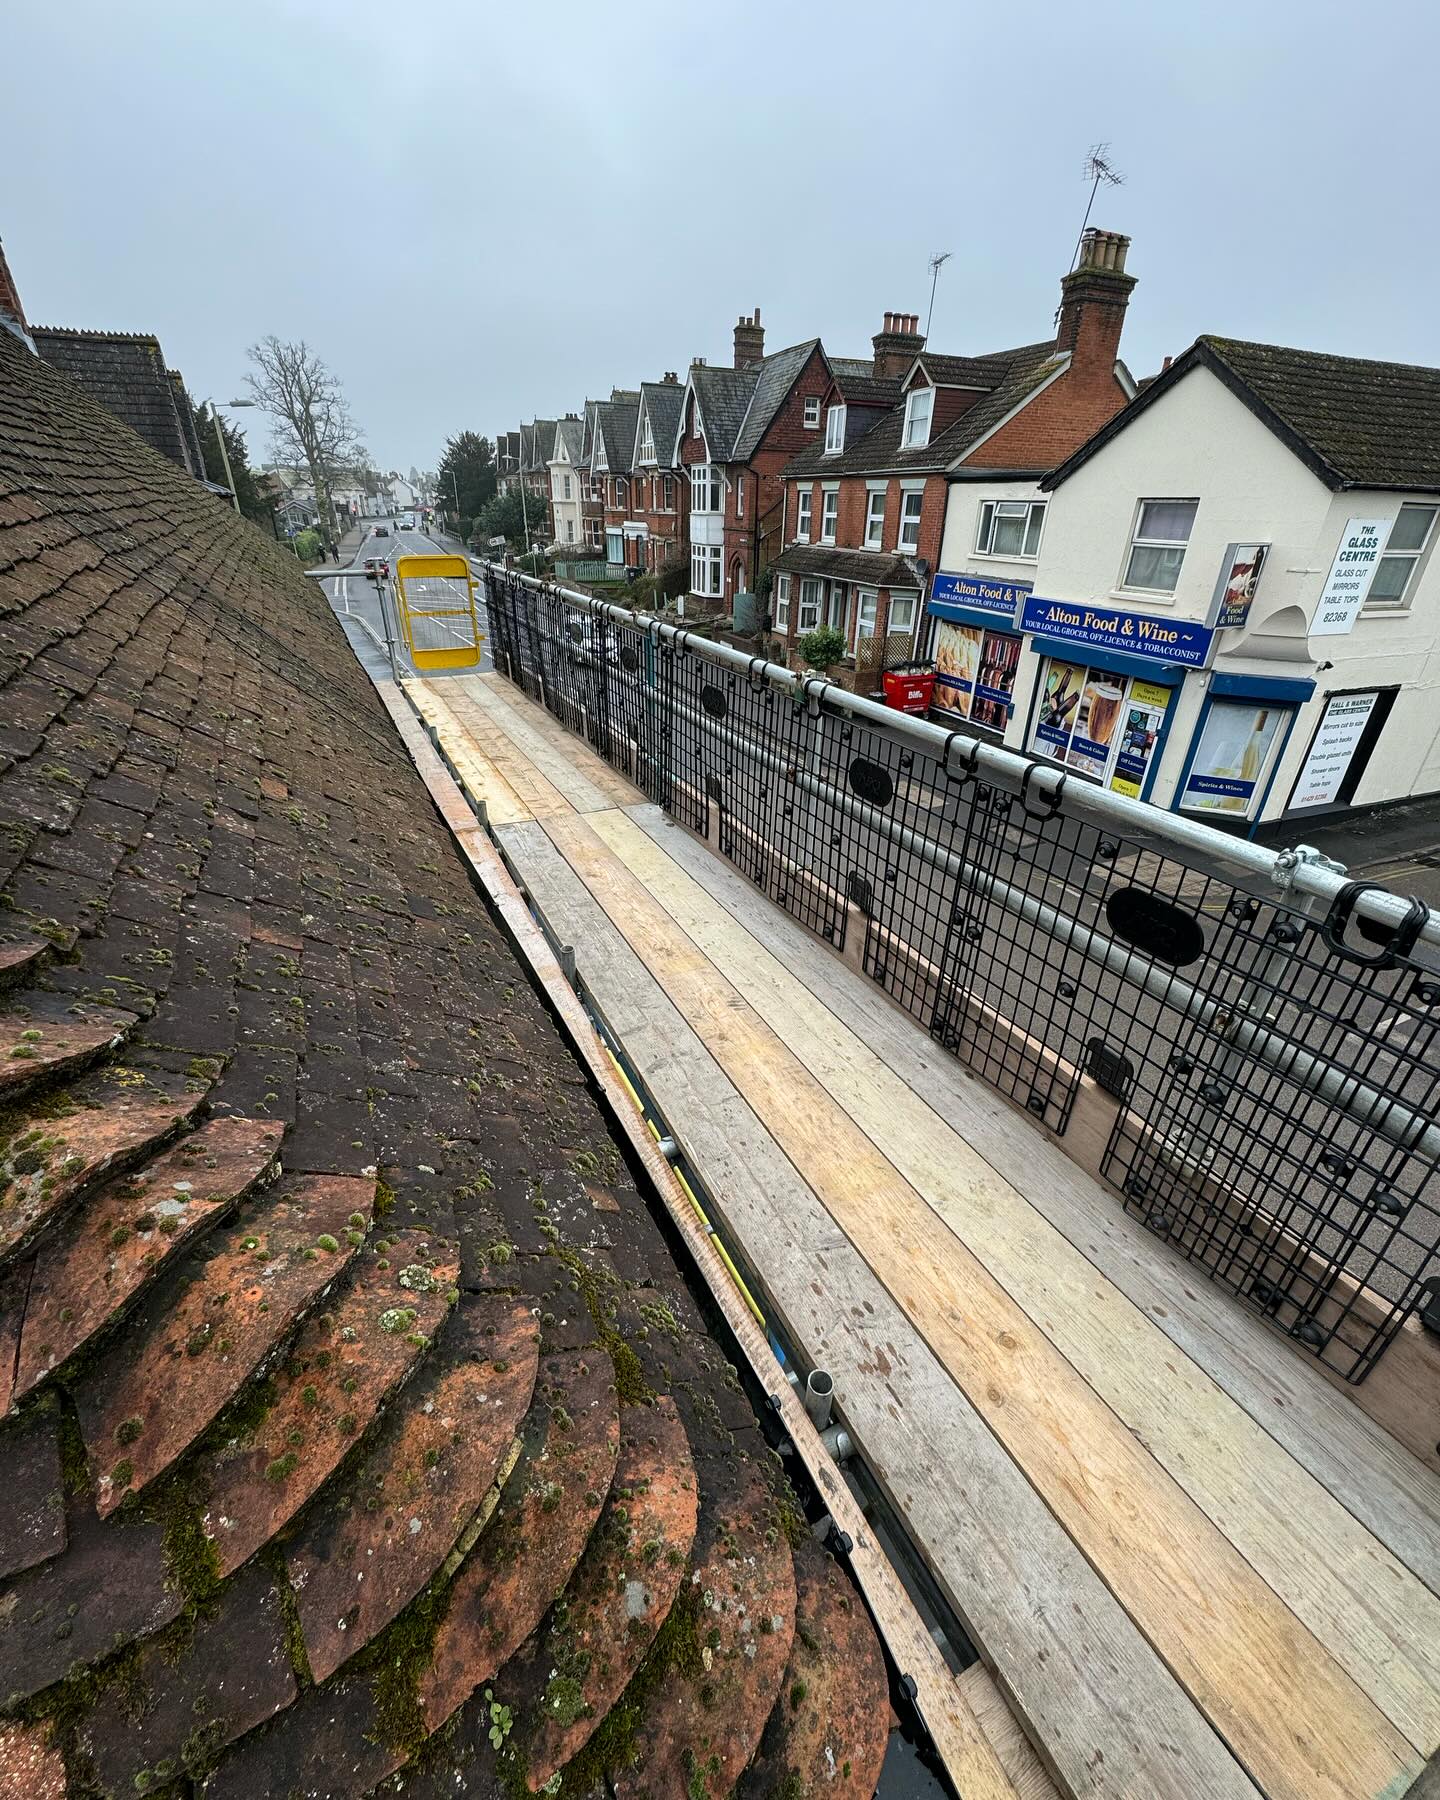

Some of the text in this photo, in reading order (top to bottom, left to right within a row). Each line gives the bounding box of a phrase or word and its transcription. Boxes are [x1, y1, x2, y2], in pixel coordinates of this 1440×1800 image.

[1360, 526, 1376, 535] THE
[1348, 537, 1379, 548] GLASS
[1339, 551, 1377, 562] CENTRE
[1335, 569, 1368, 577] GLASS CUT
[953, 581, 977, 597] Alton
[978, 584, 1002, 600] Food
[1004, 588, 1014, 601] &
[1332, 582, 1360, 591] MIRRORS
[951, 593, 963, 601] LOCAL
[1324, 595, 1359, 604] TABLE TOPS
[1226, 606, 1244, 615] Food
[1227, 616, 1245, 624] Wine
[1323, 612, 1348, 622] 82368
[1045, 606, 1080, 626] Alton
[1082, 612, 1119, 633] Food
[1121, 618, 1134, 636] &
[1138, 621, 1178, 643] Wine
[1025, 619, 1201, 660] YOUR LOCAL GROCER, OFF-LICENCE & TOBACCONIST
[908, 690, 923, 699] Biffa
[1330, 701, 1345, 709] HALL
[1351, 698, 1374, 707] WARNER
